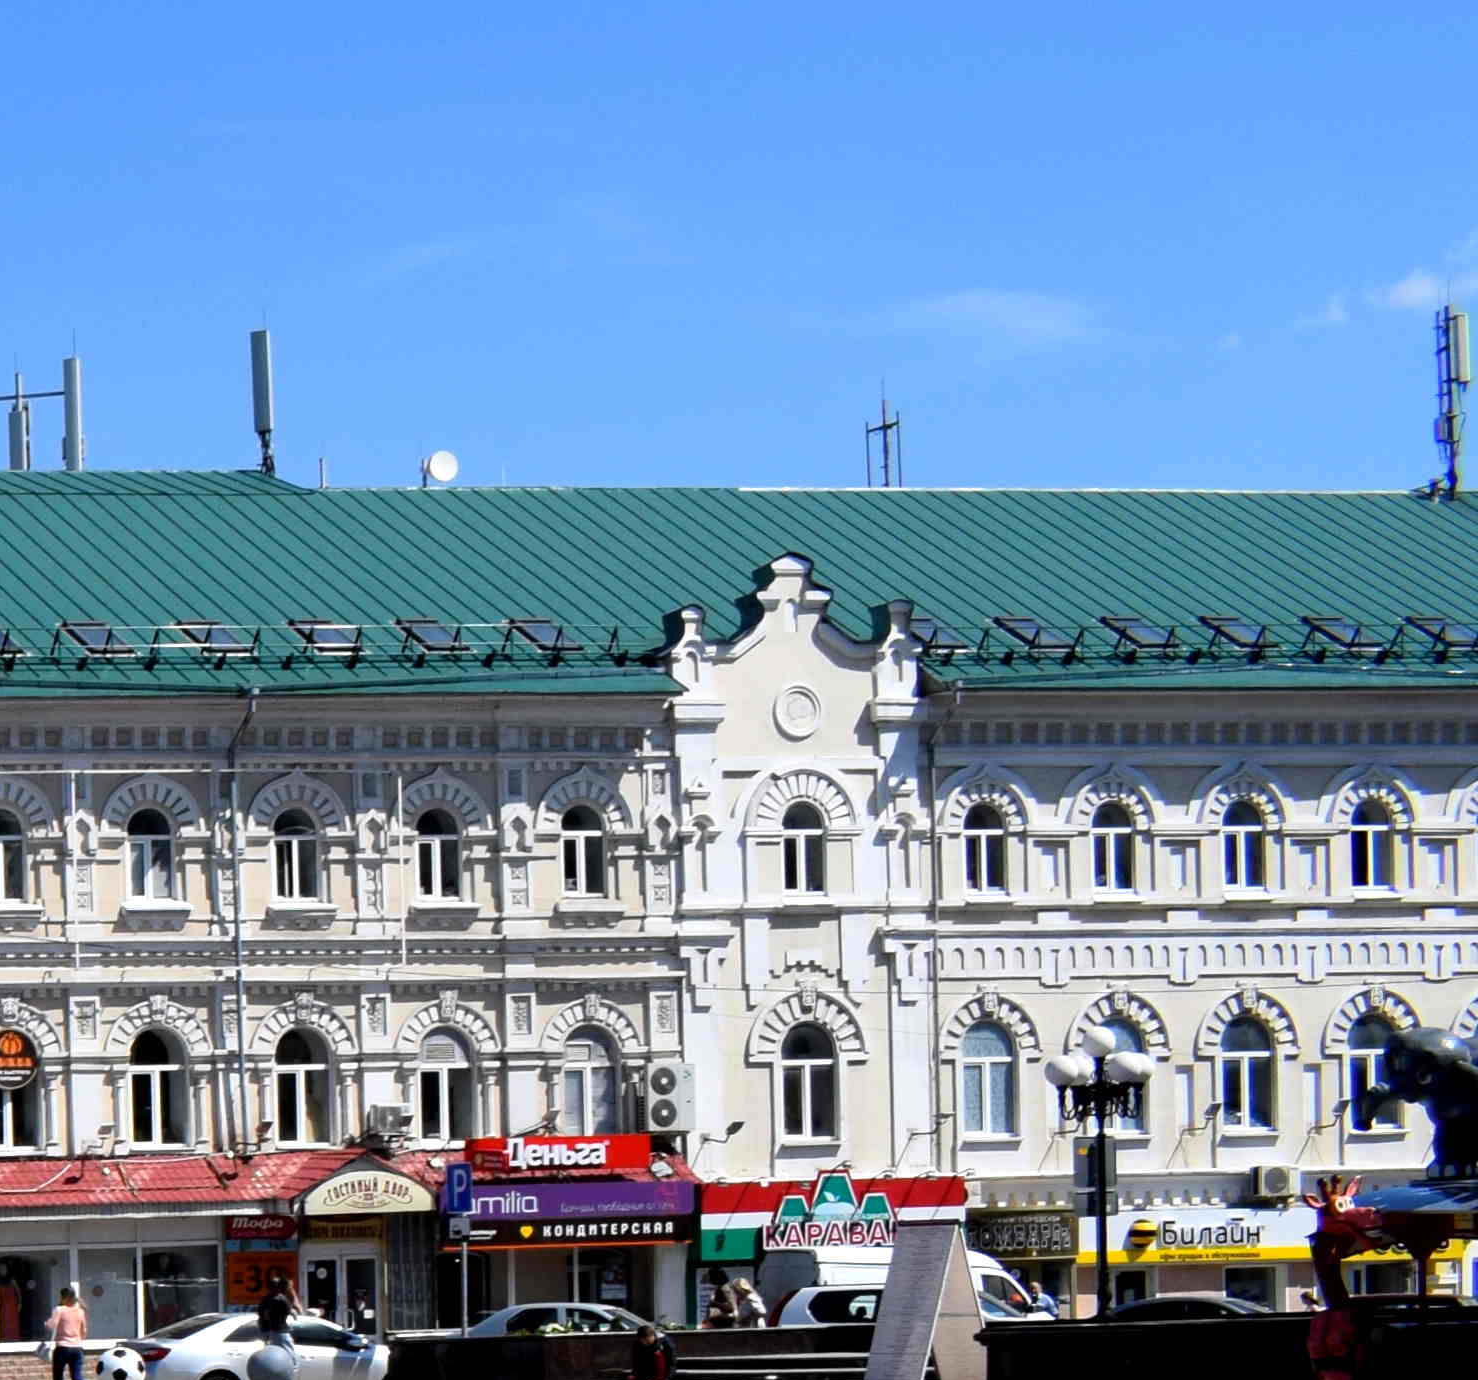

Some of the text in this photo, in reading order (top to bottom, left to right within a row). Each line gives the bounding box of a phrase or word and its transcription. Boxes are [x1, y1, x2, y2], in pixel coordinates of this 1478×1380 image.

[503, 1137, 607, 1169] Деньга
[327, 1177, 379, 1202] ГОСТИНЫЙ
[382, 1180, 412, 1200] ДВОР
[542, 1221, 674, 1238] КОНДИТЕРСКАЯ
[1160, 1217, 1262, 1246] Билайн
